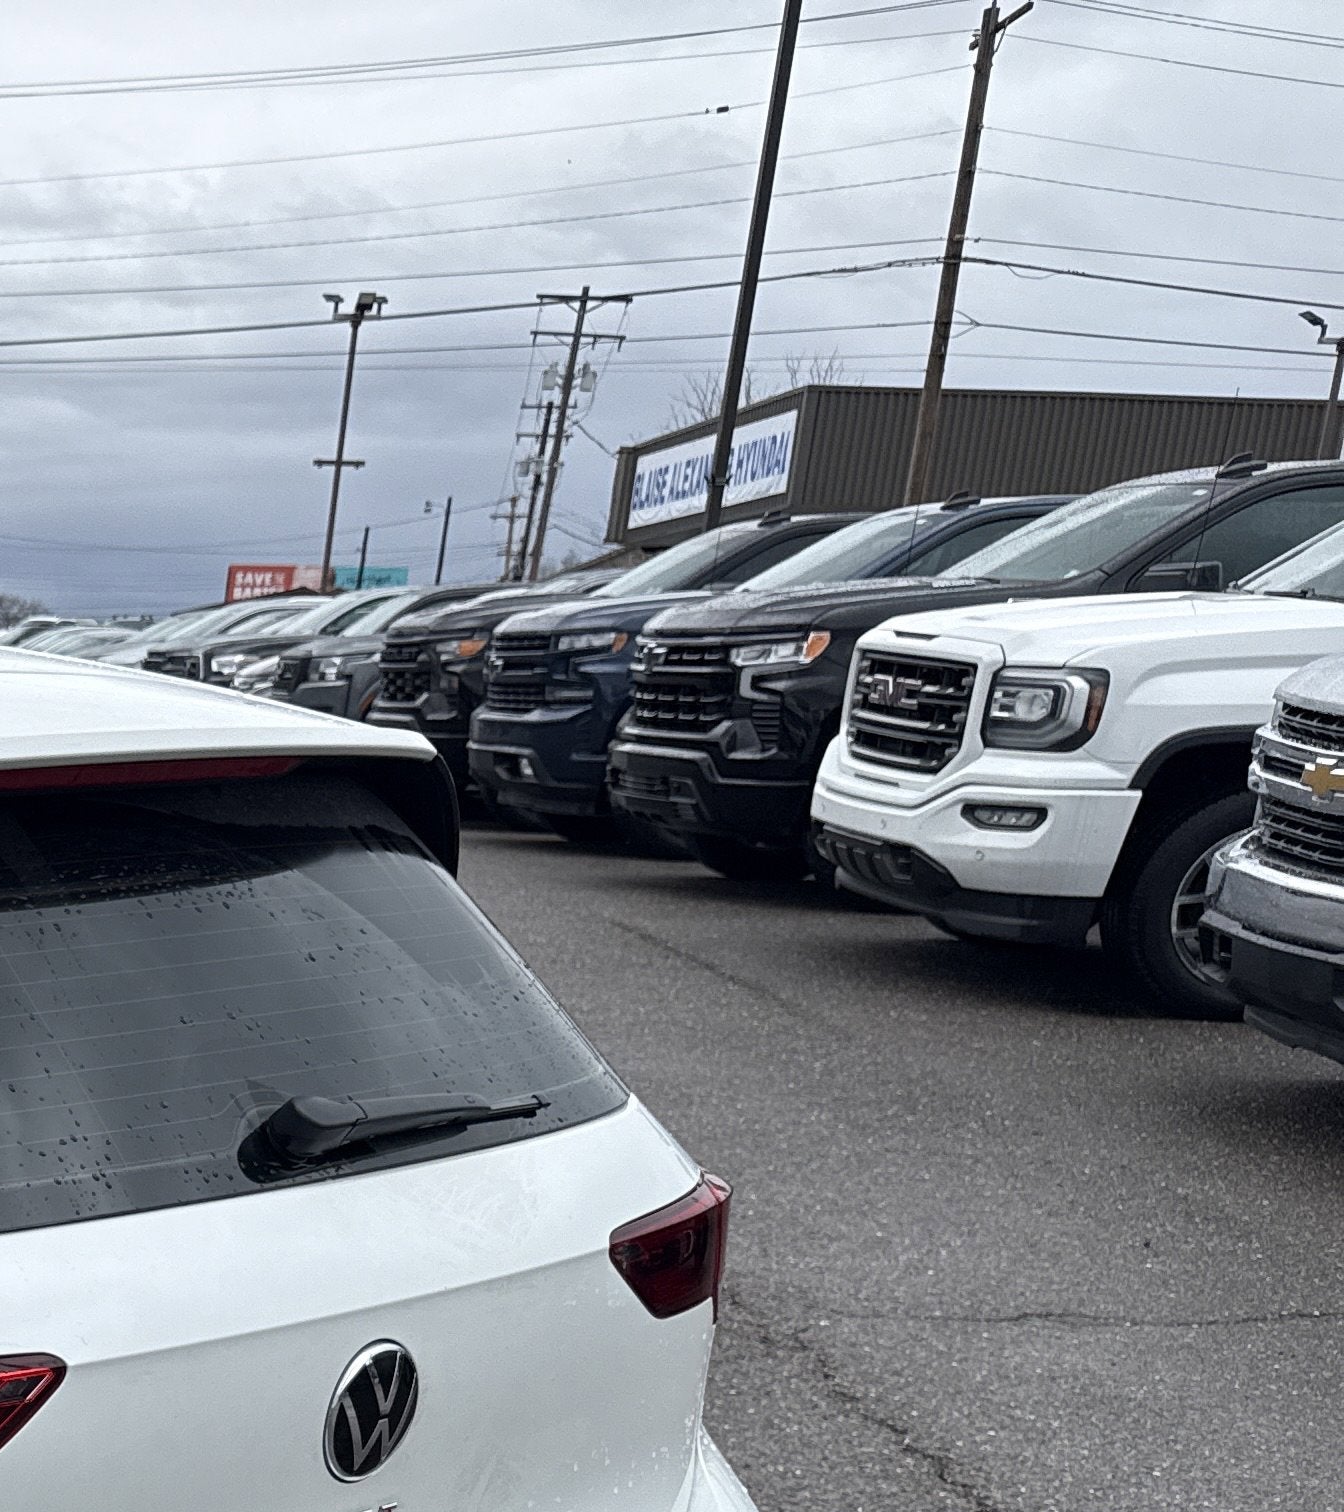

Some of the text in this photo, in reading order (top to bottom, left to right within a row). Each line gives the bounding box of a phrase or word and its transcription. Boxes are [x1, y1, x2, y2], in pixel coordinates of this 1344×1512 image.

[632, 465, 669, 511] BLAISE
[734, 431, 791, 486] HYUNDAI
[235, 570, 273, 586] SAVE
